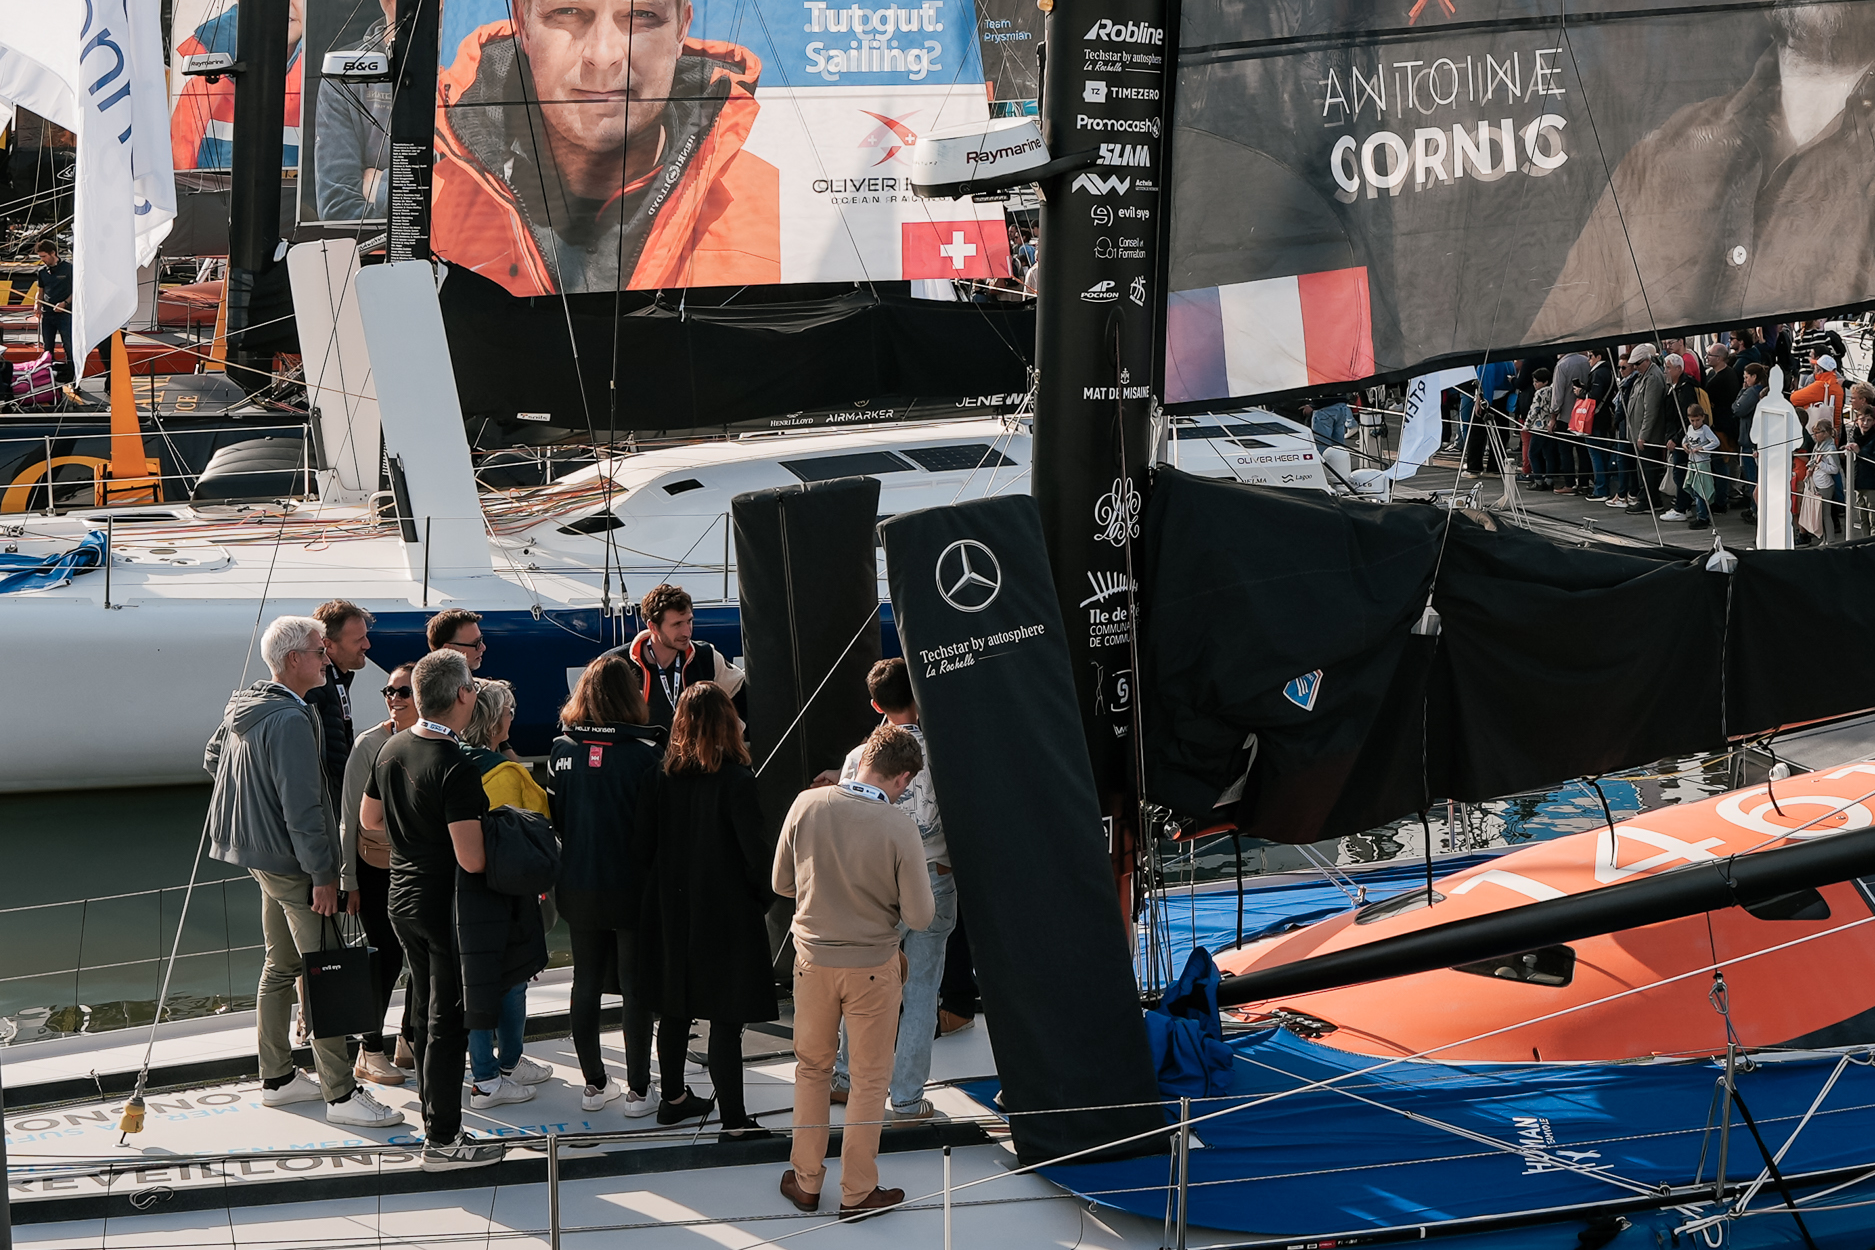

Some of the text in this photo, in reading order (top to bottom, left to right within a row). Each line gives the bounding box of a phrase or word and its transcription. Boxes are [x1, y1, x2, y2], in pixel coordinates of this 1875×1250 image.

[984, 19, 1012, 29] Team
[984, 30, 1032, 44] Prysmian
[1084, 18, 1164, 46] Robline
[190, 58, 224, 67] Raymarine
[805, 41, 929, 81] Sailing
[1084, 48, 1162, 66] Techstar by autosphere
[343, 61, 379, 71] B&G
[1084, 61, 1122, 73] La Rochelle
[1322, 47, 1567, 117] ANTOINE
[1110, 87, 1160, 100] TIMEZERO
[1076, 114, 1152, 133] Promocash
[966, 137, 1042, 165] Raymarine
[1096, 143, 1150, 167] SLAM
[1330, 113, 1570, 194] CORNIC
[812, 177, 897, 193] OLIVER
[831, 196, 880, 205] OCEAN
[1118, 205, 1136, 218] evil
[1080, 291, 1119, 299] POCHON
[1083, 385, 1150, 400] MAT DE MISAINE
[770, 417, 814, 429] HENRI LLOYD
[825, 408, 895, 423] AIRMARKER
[1237, 454, 1300, 465] OLIVER HEER
[1112, 606, 1128, 622] de
[919, 622, 1045, 665] Techstar by autosphere
[1090, 636, 1102, 648] DE
[925, 653, 976, 679] La Rochelle
